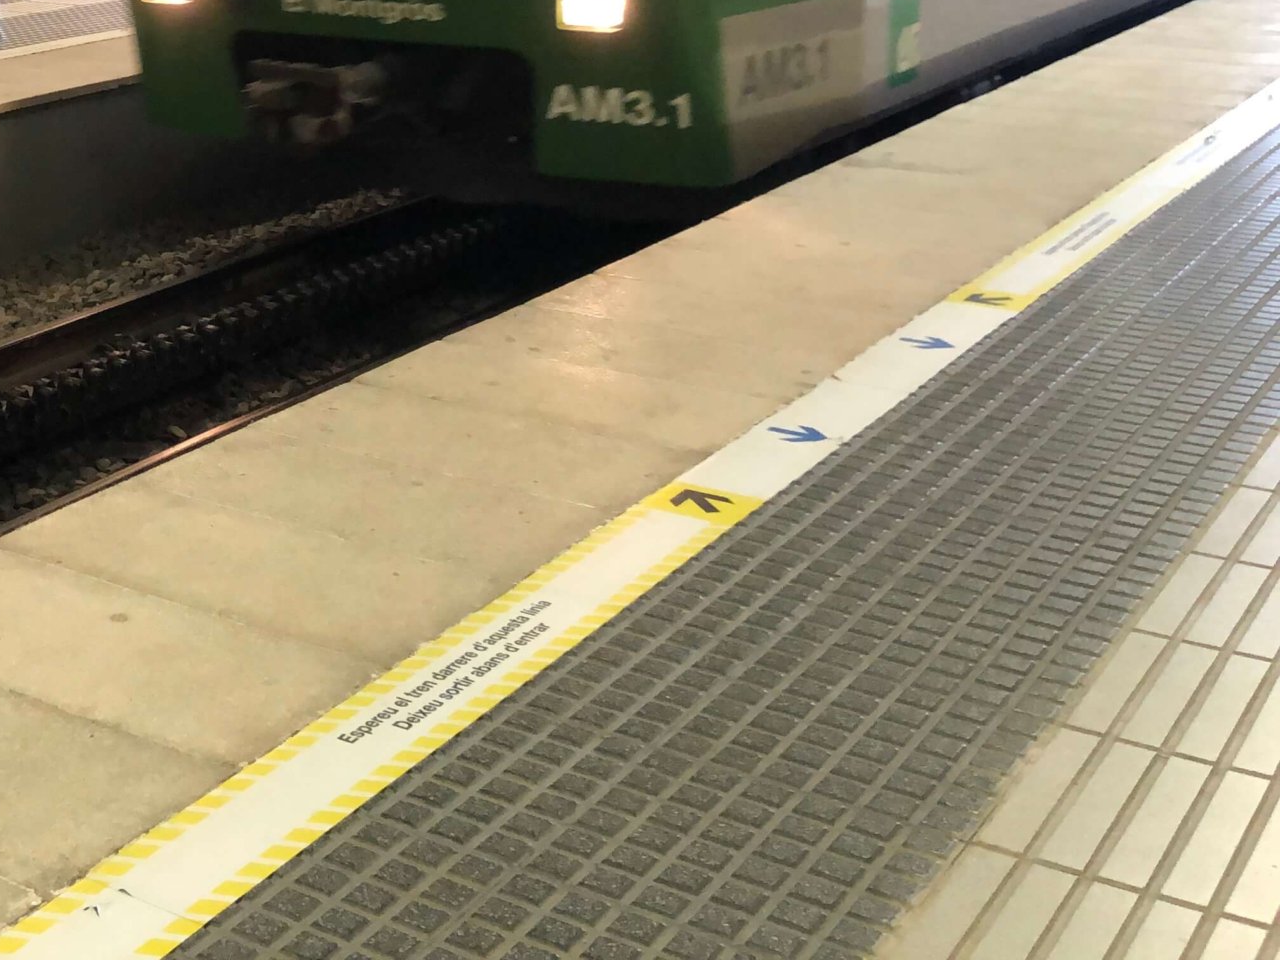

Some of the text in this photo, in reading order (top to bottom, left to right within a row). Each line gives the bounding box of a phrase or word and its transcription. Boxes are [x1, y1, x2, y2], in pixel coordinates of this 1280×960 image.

[545, 83, 693, 130] AM3.1
[337, 706, 399, 744] Espereu
[394, 692, 410, 708] el
[406, 679, 436, 699] tren
[432, 649, 478, 682] darrere
[472, 614, 530, 653] d'aquesta
[392, 621, 550, 731] Deixeu sortir abans d'entrar
